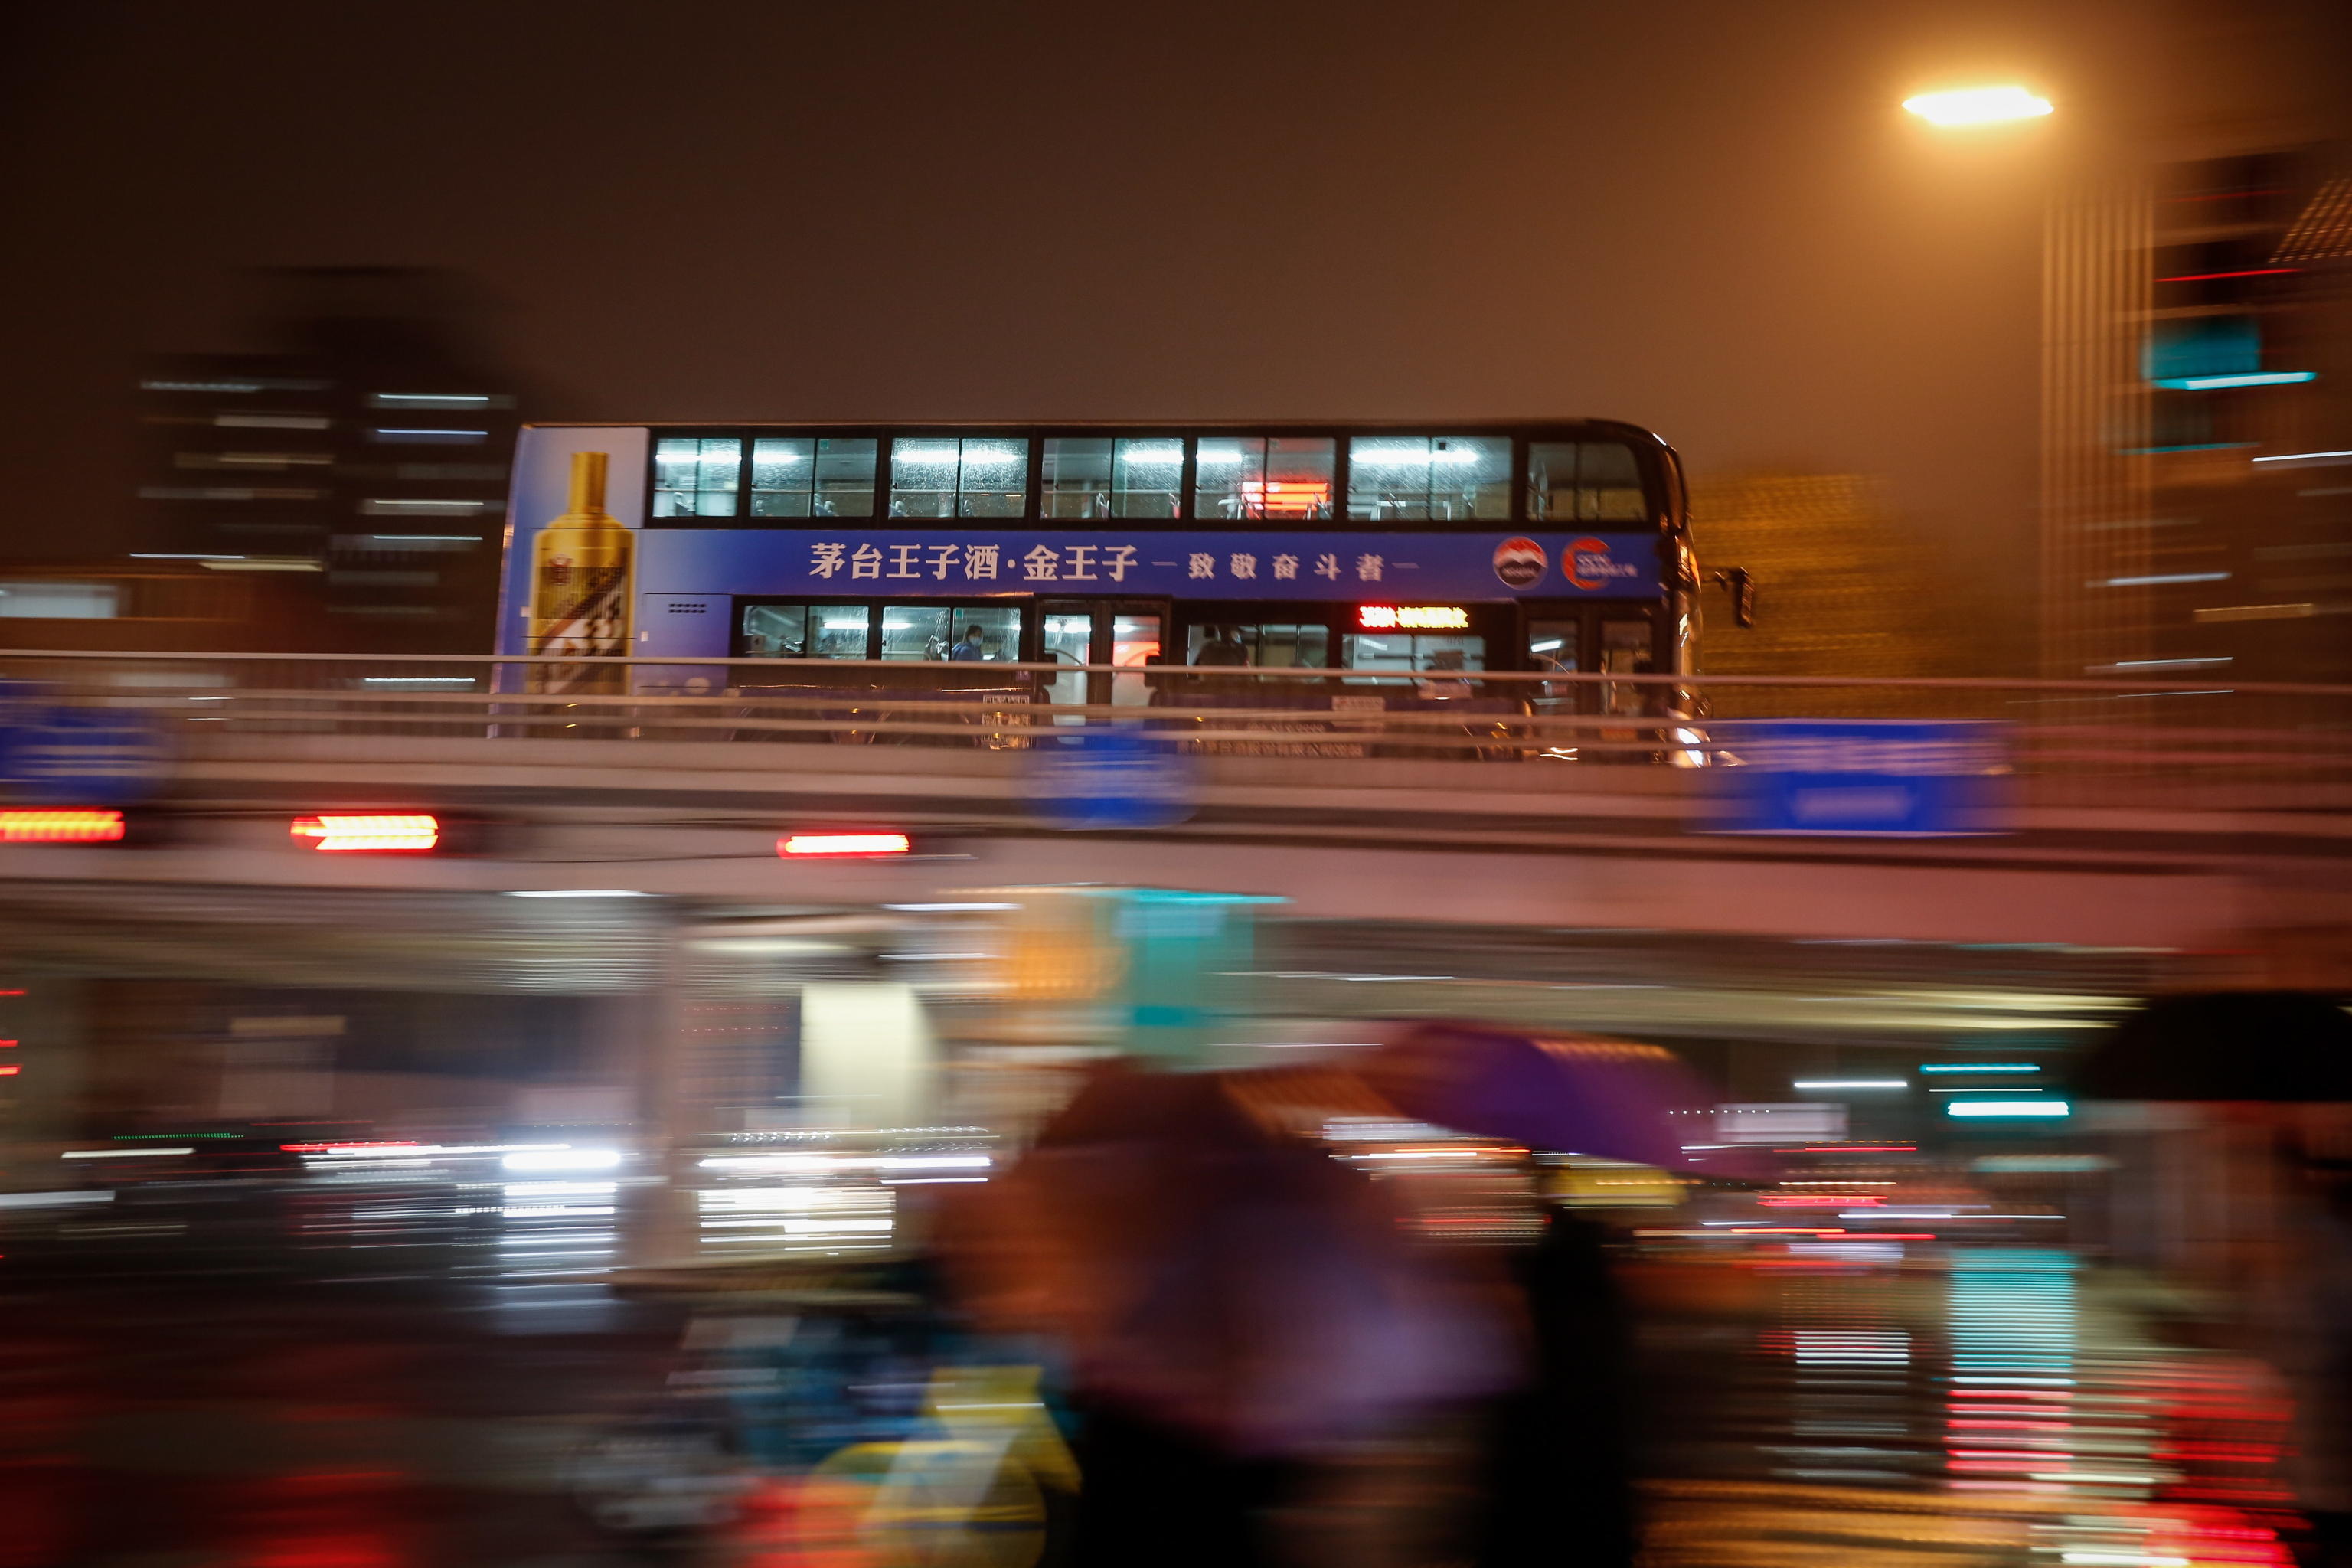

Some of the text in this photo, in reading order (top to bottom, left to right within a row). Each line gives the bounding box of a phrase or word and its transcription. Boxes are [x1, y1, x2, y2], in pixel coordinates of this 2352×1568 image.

[809, 542, 1138, 582] 茅台王子酒·金王子
